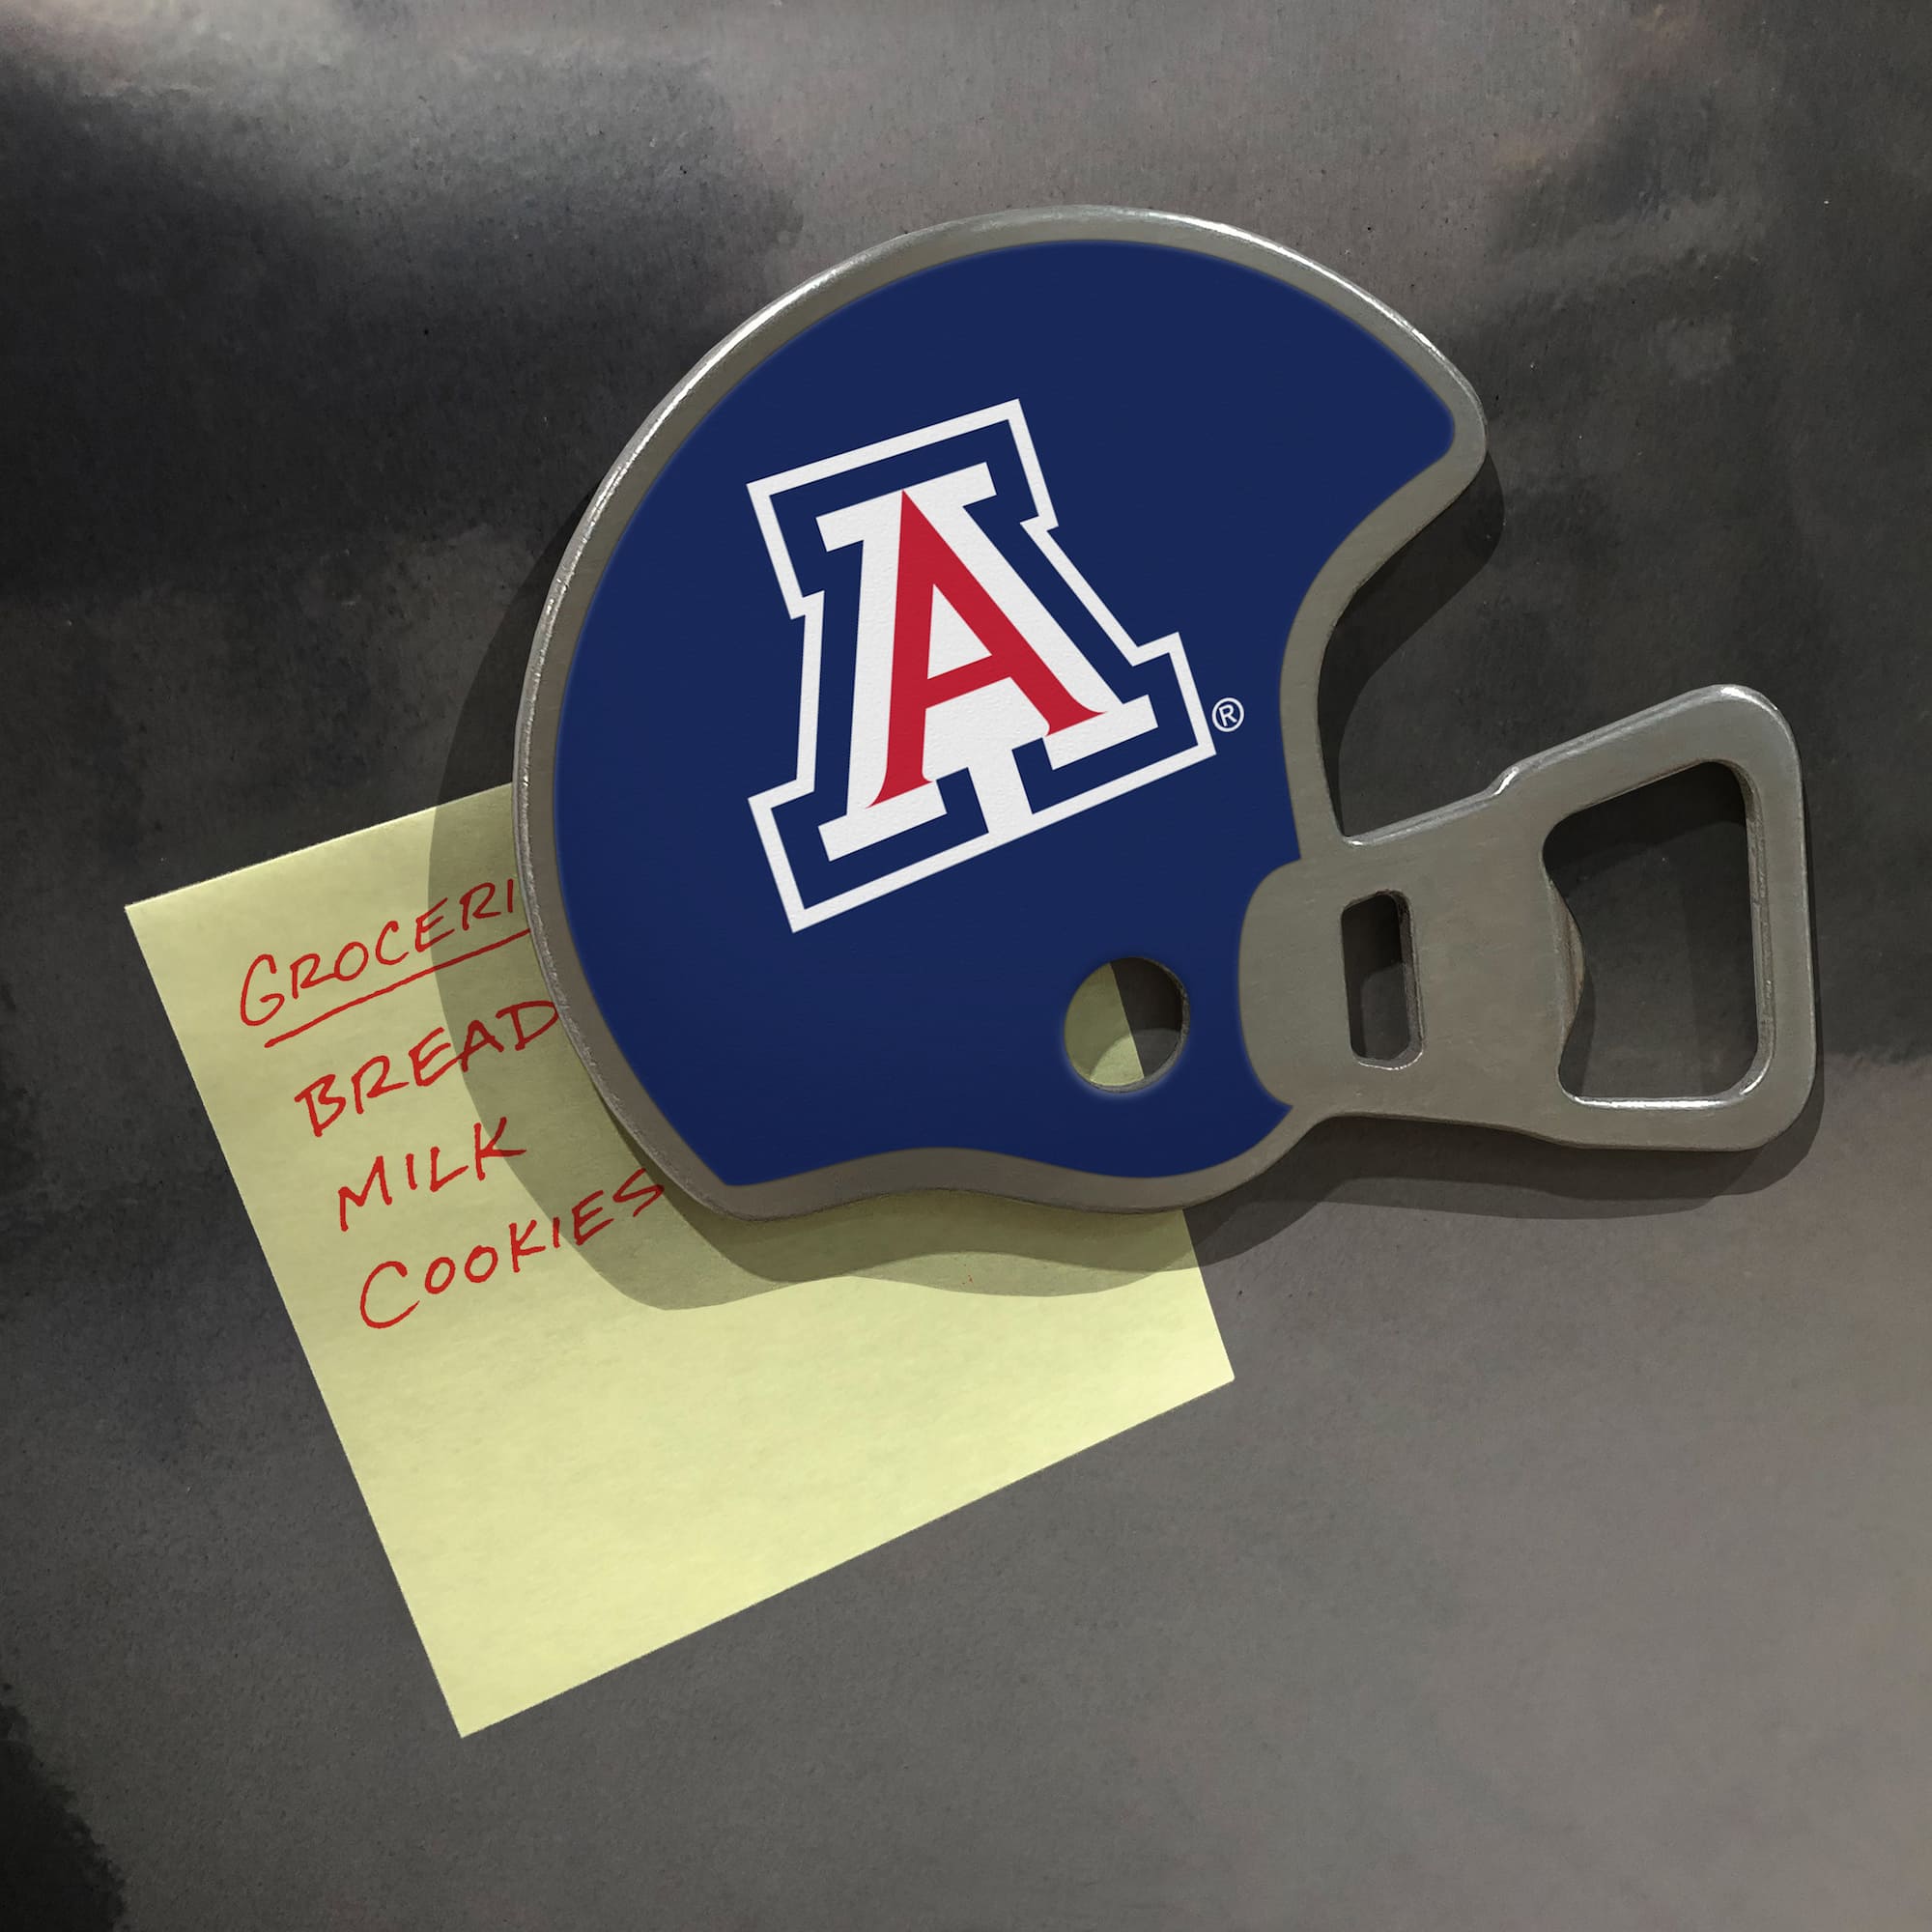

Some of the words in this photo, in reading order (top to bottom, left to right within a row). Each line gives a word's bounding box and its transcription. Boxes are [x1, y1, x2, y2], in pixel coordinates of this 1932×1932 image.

[240, 878, 515, 1027] GROCERI
[294, 1000, 559, 1138] BREAD
[338, 1117, 526, 1233] MILK
[359, 1167, 666, 1330] COOKIES
